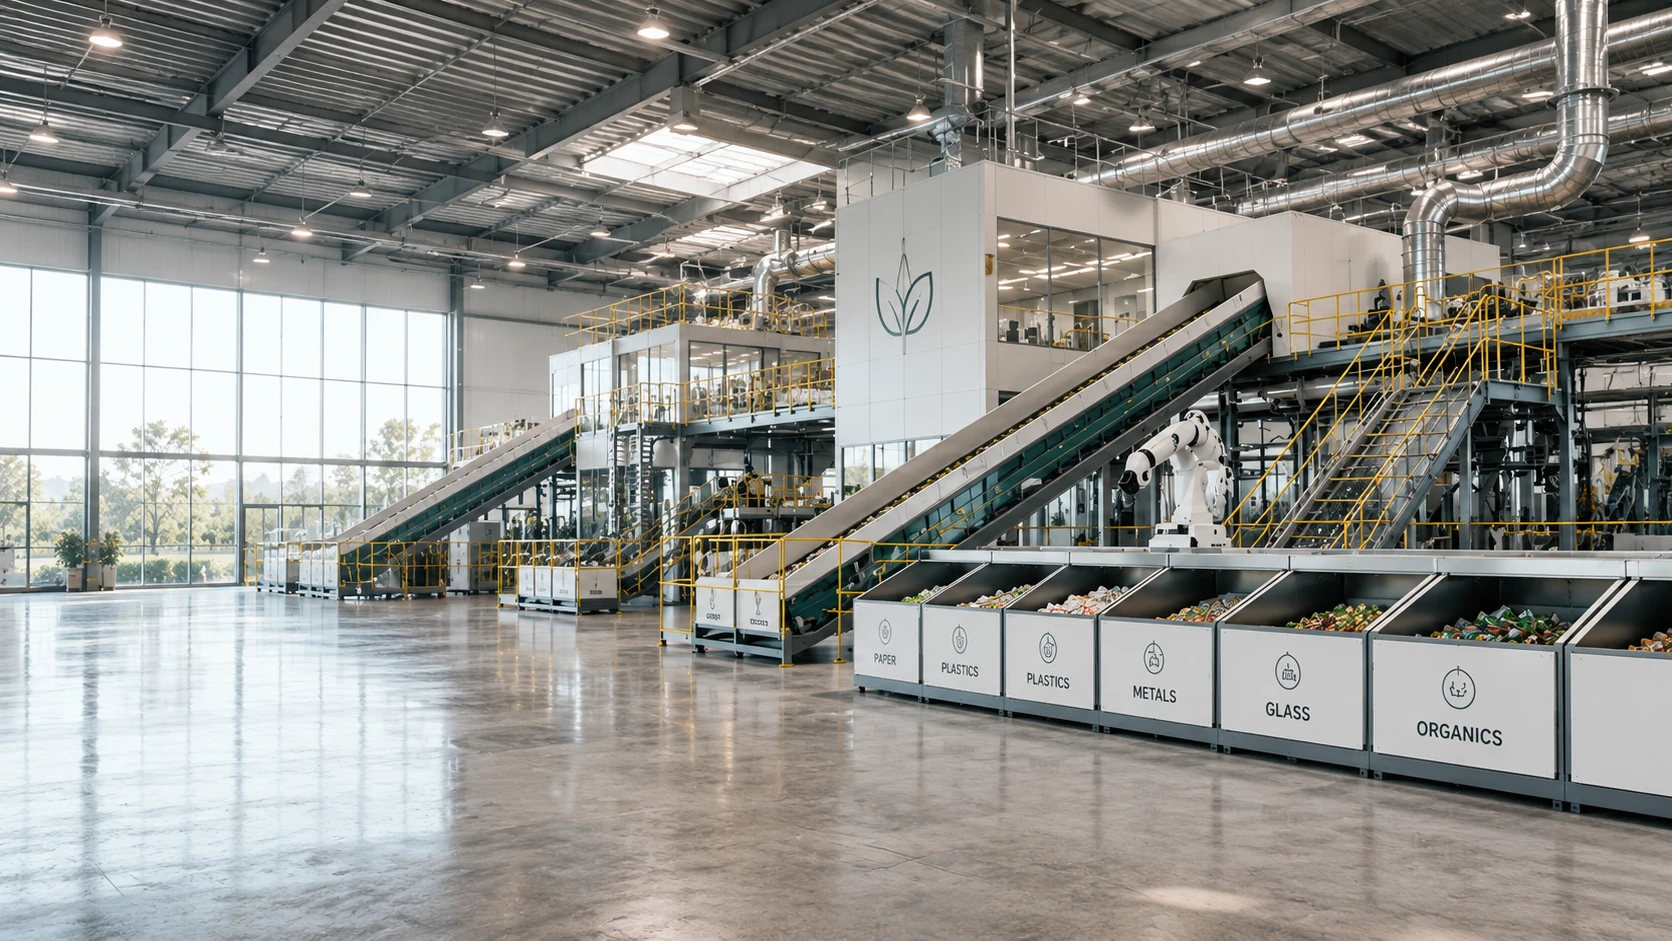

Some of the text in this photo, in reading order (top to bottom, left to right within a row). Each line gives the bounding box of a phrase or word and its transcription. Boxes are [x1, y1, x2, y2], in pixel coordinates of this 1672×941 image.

[873, 652, 897, 666] PAPER
[941, 661, 979, 678] PLASTICS
[1026, 672, 1070, 690] PLASTICS
[1132, 684, 1177, 704] METALS
[1265, 701, 1311, 722] GLASS
[1416, 720, 1503, 747] ORGANICS
